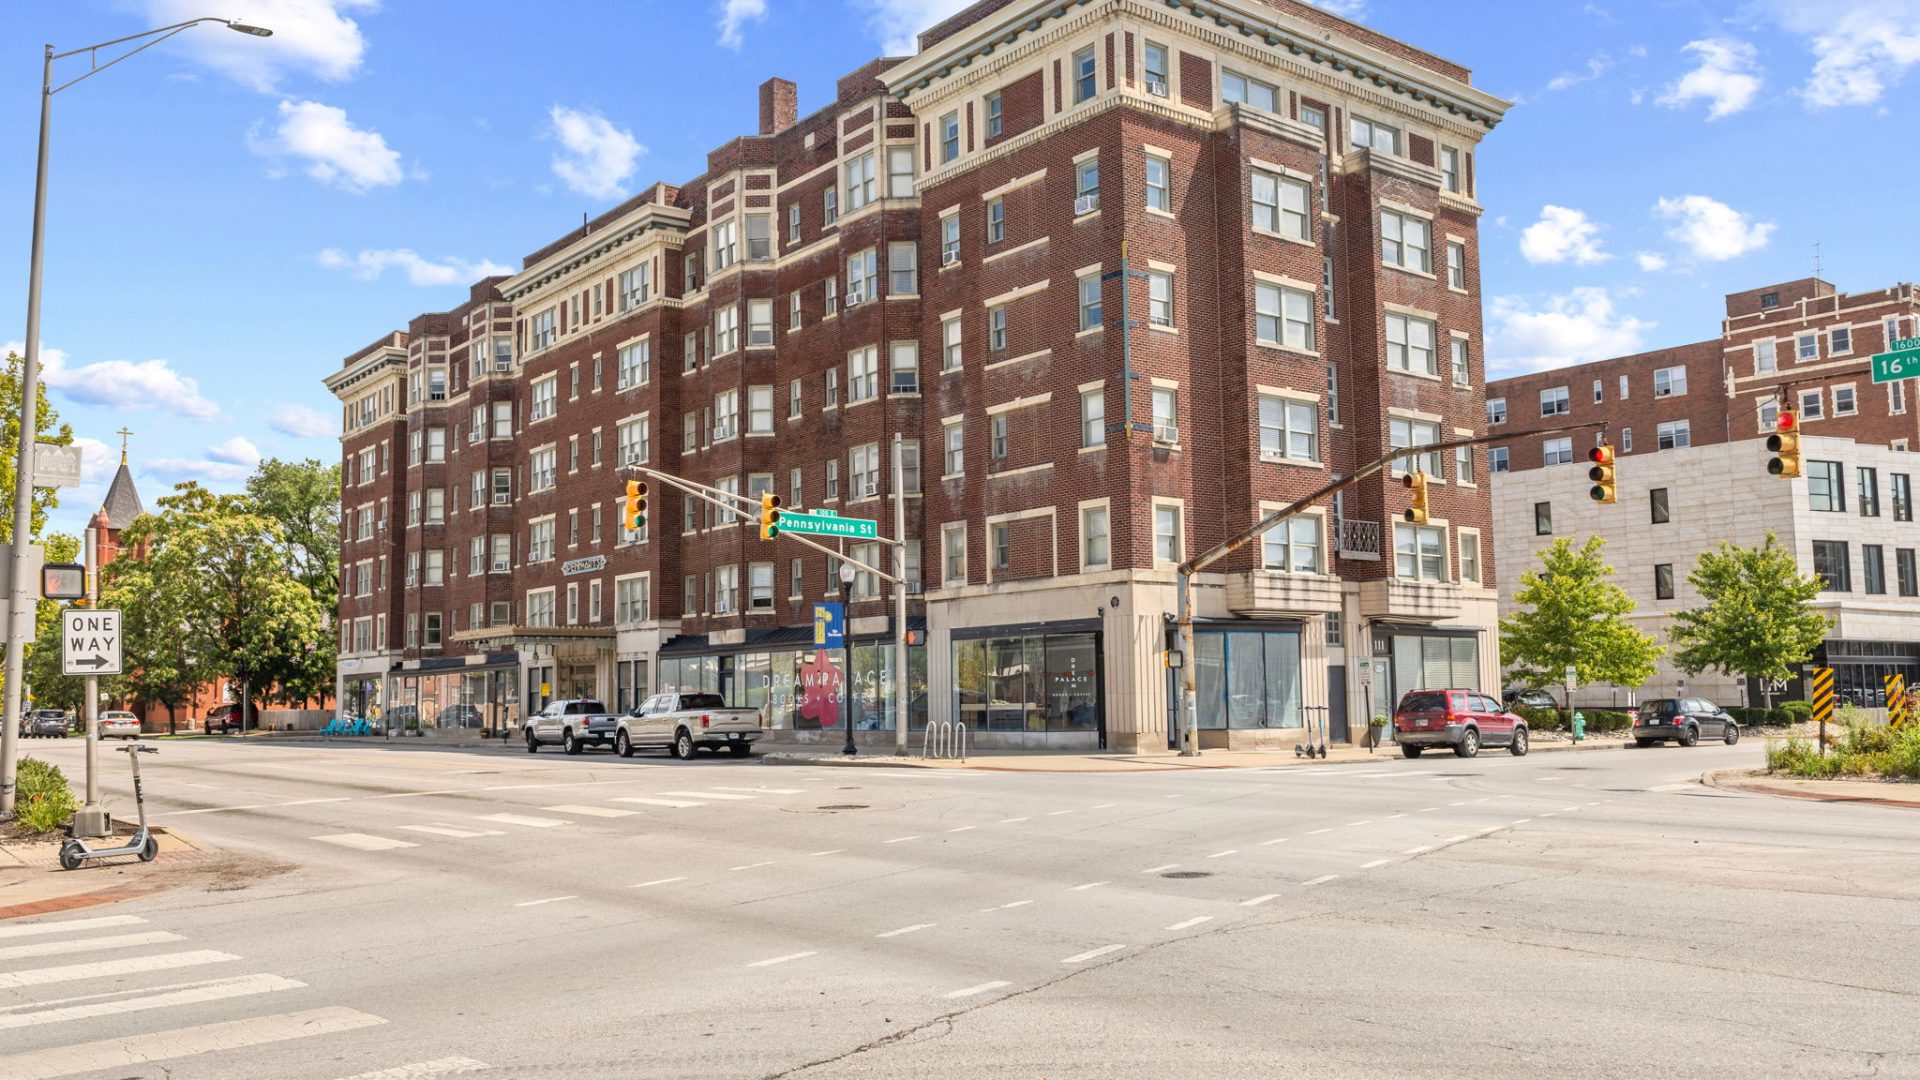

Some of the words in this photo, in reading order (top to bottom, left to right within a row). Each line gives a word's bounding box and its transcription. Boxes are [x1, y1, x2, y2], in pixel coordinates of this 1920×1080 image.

[779, 516, 855, 534] Pennsylvania
[860, 523, 872, 534] St
[72, 617, 113, 631] ONE
[71, 637, 114, 651] WAY
[762, 673, 814, 688] DREAM
[822, 670, 887, 686] PAACE
[828, 692, 875, 703] COFEE
